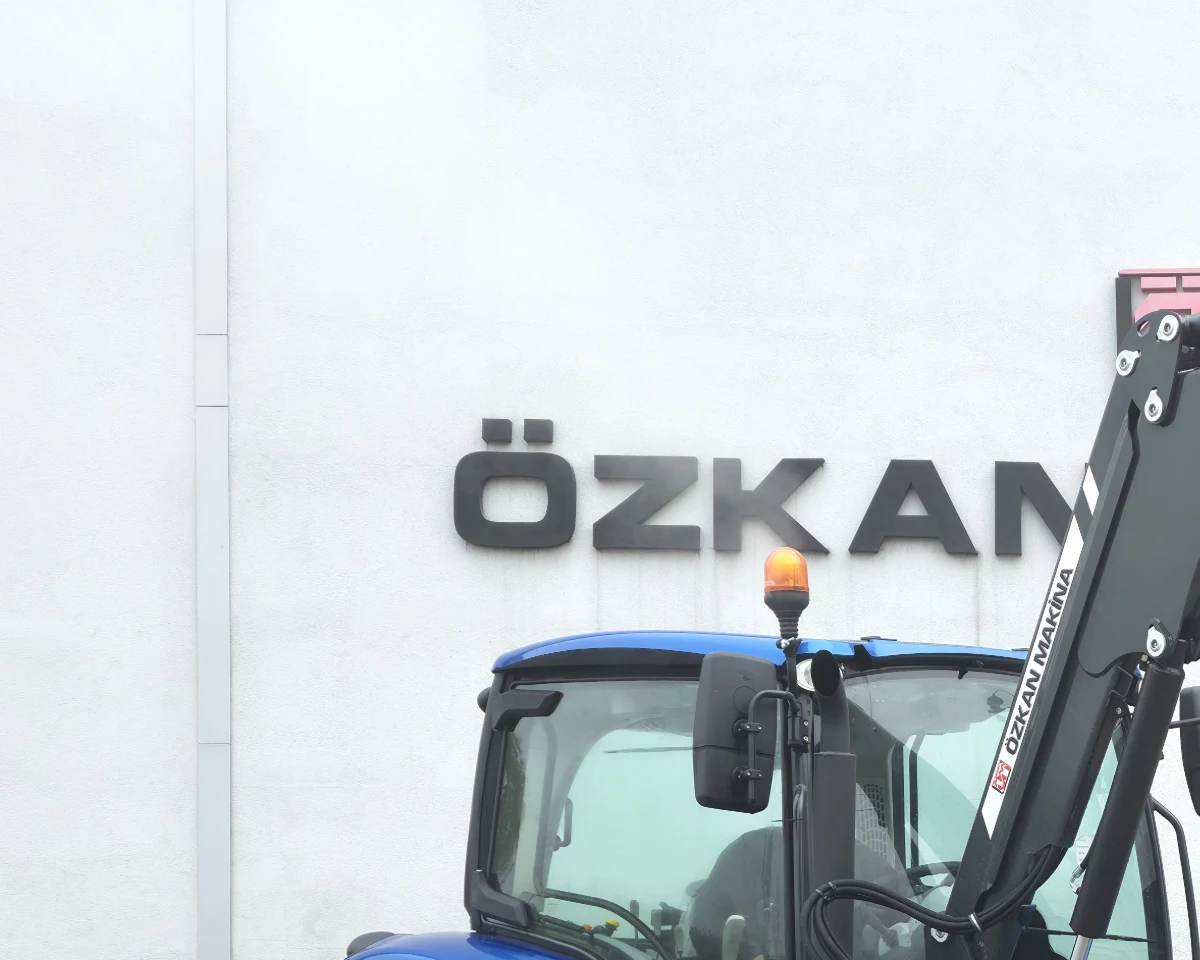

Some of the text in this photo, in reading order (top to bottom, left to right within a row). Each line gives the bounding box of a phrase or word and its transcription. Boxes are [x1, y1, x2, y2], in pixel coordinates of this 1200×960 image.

[453, 418, 1088, 556] ÖZKAN
[1004, 568, 1074, 756] ÖZKAN MAKİNA
